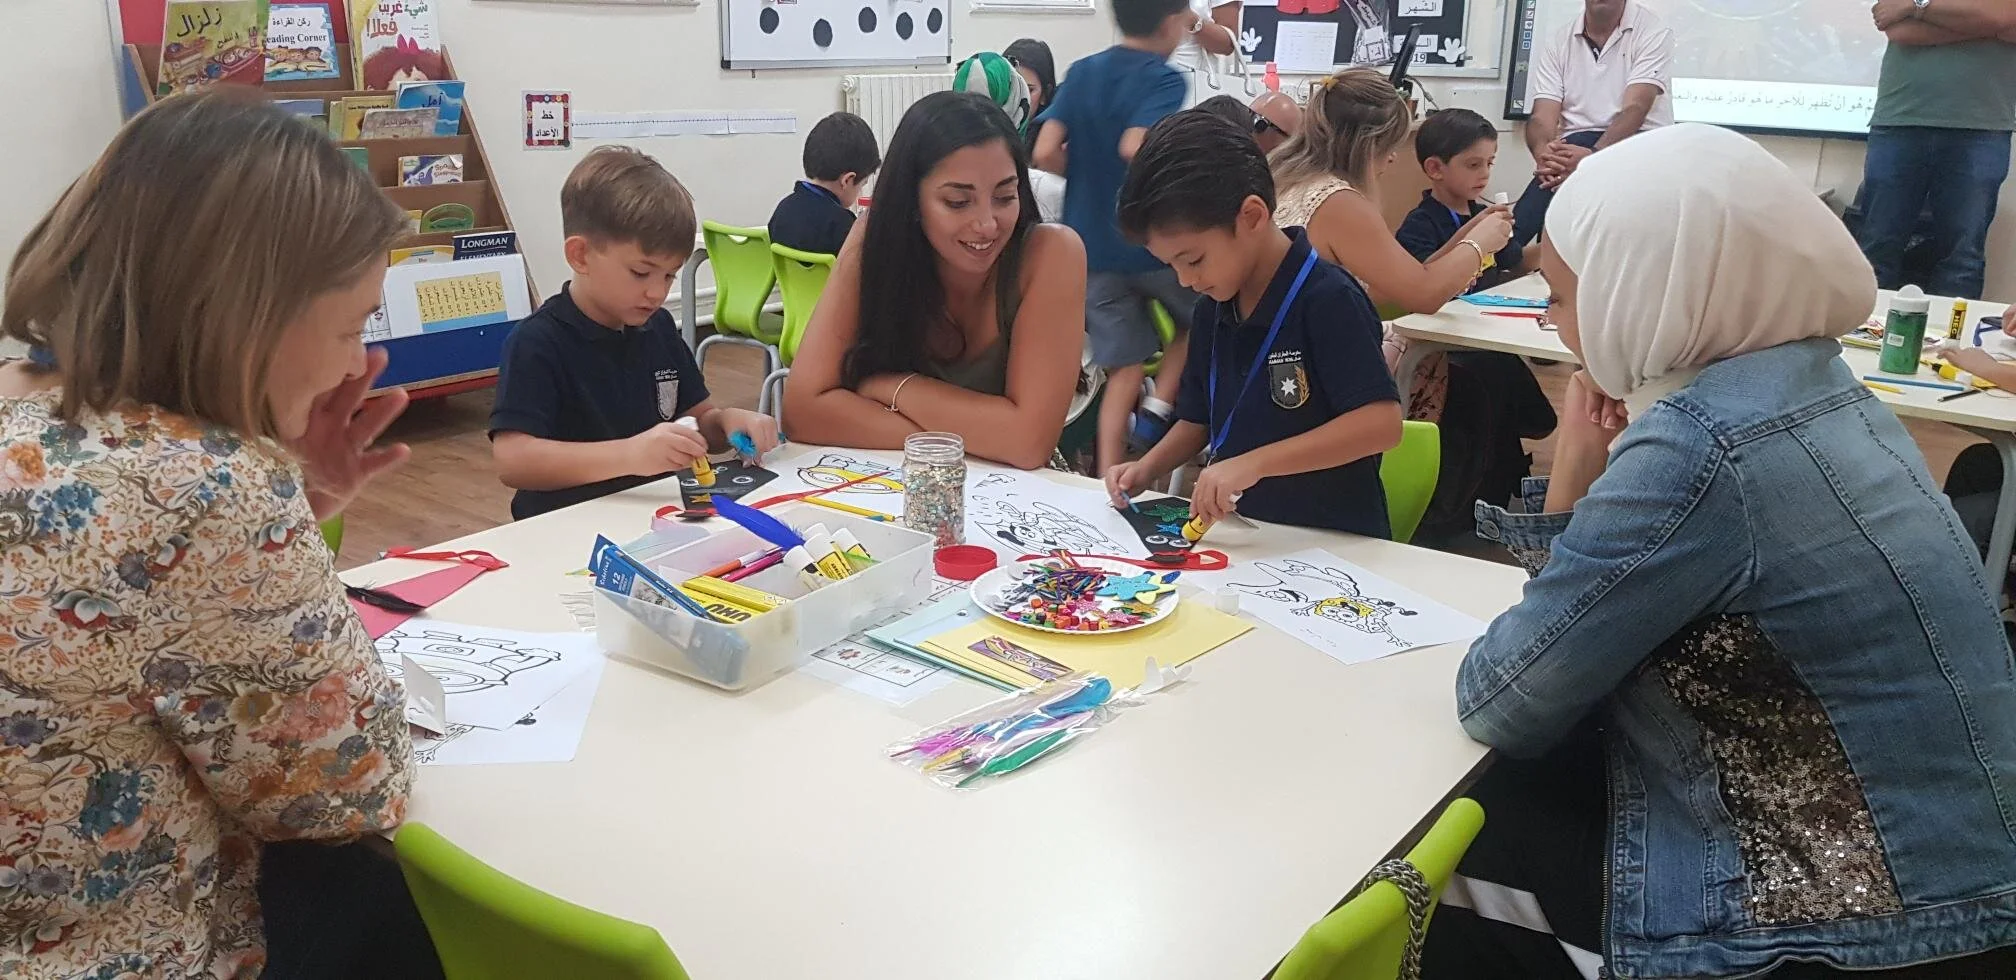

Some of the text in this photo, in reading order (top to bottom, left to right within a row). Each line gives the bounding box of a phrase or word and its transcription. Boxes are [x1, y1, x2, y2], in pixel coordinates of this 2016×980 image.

[177, 7, 222, 38] زلزال
[272, 17, 311, 27] ركن القراءة
[265, 33, 327, 44] eading Corner
[541, 110, 554, 121] خط
[535, 128, 559, 139] الأعداد
[461, 237, 508, 249] LONGMAN
[612, 572, 622, 585] 12
[705, 603, 751, 621] UHU
